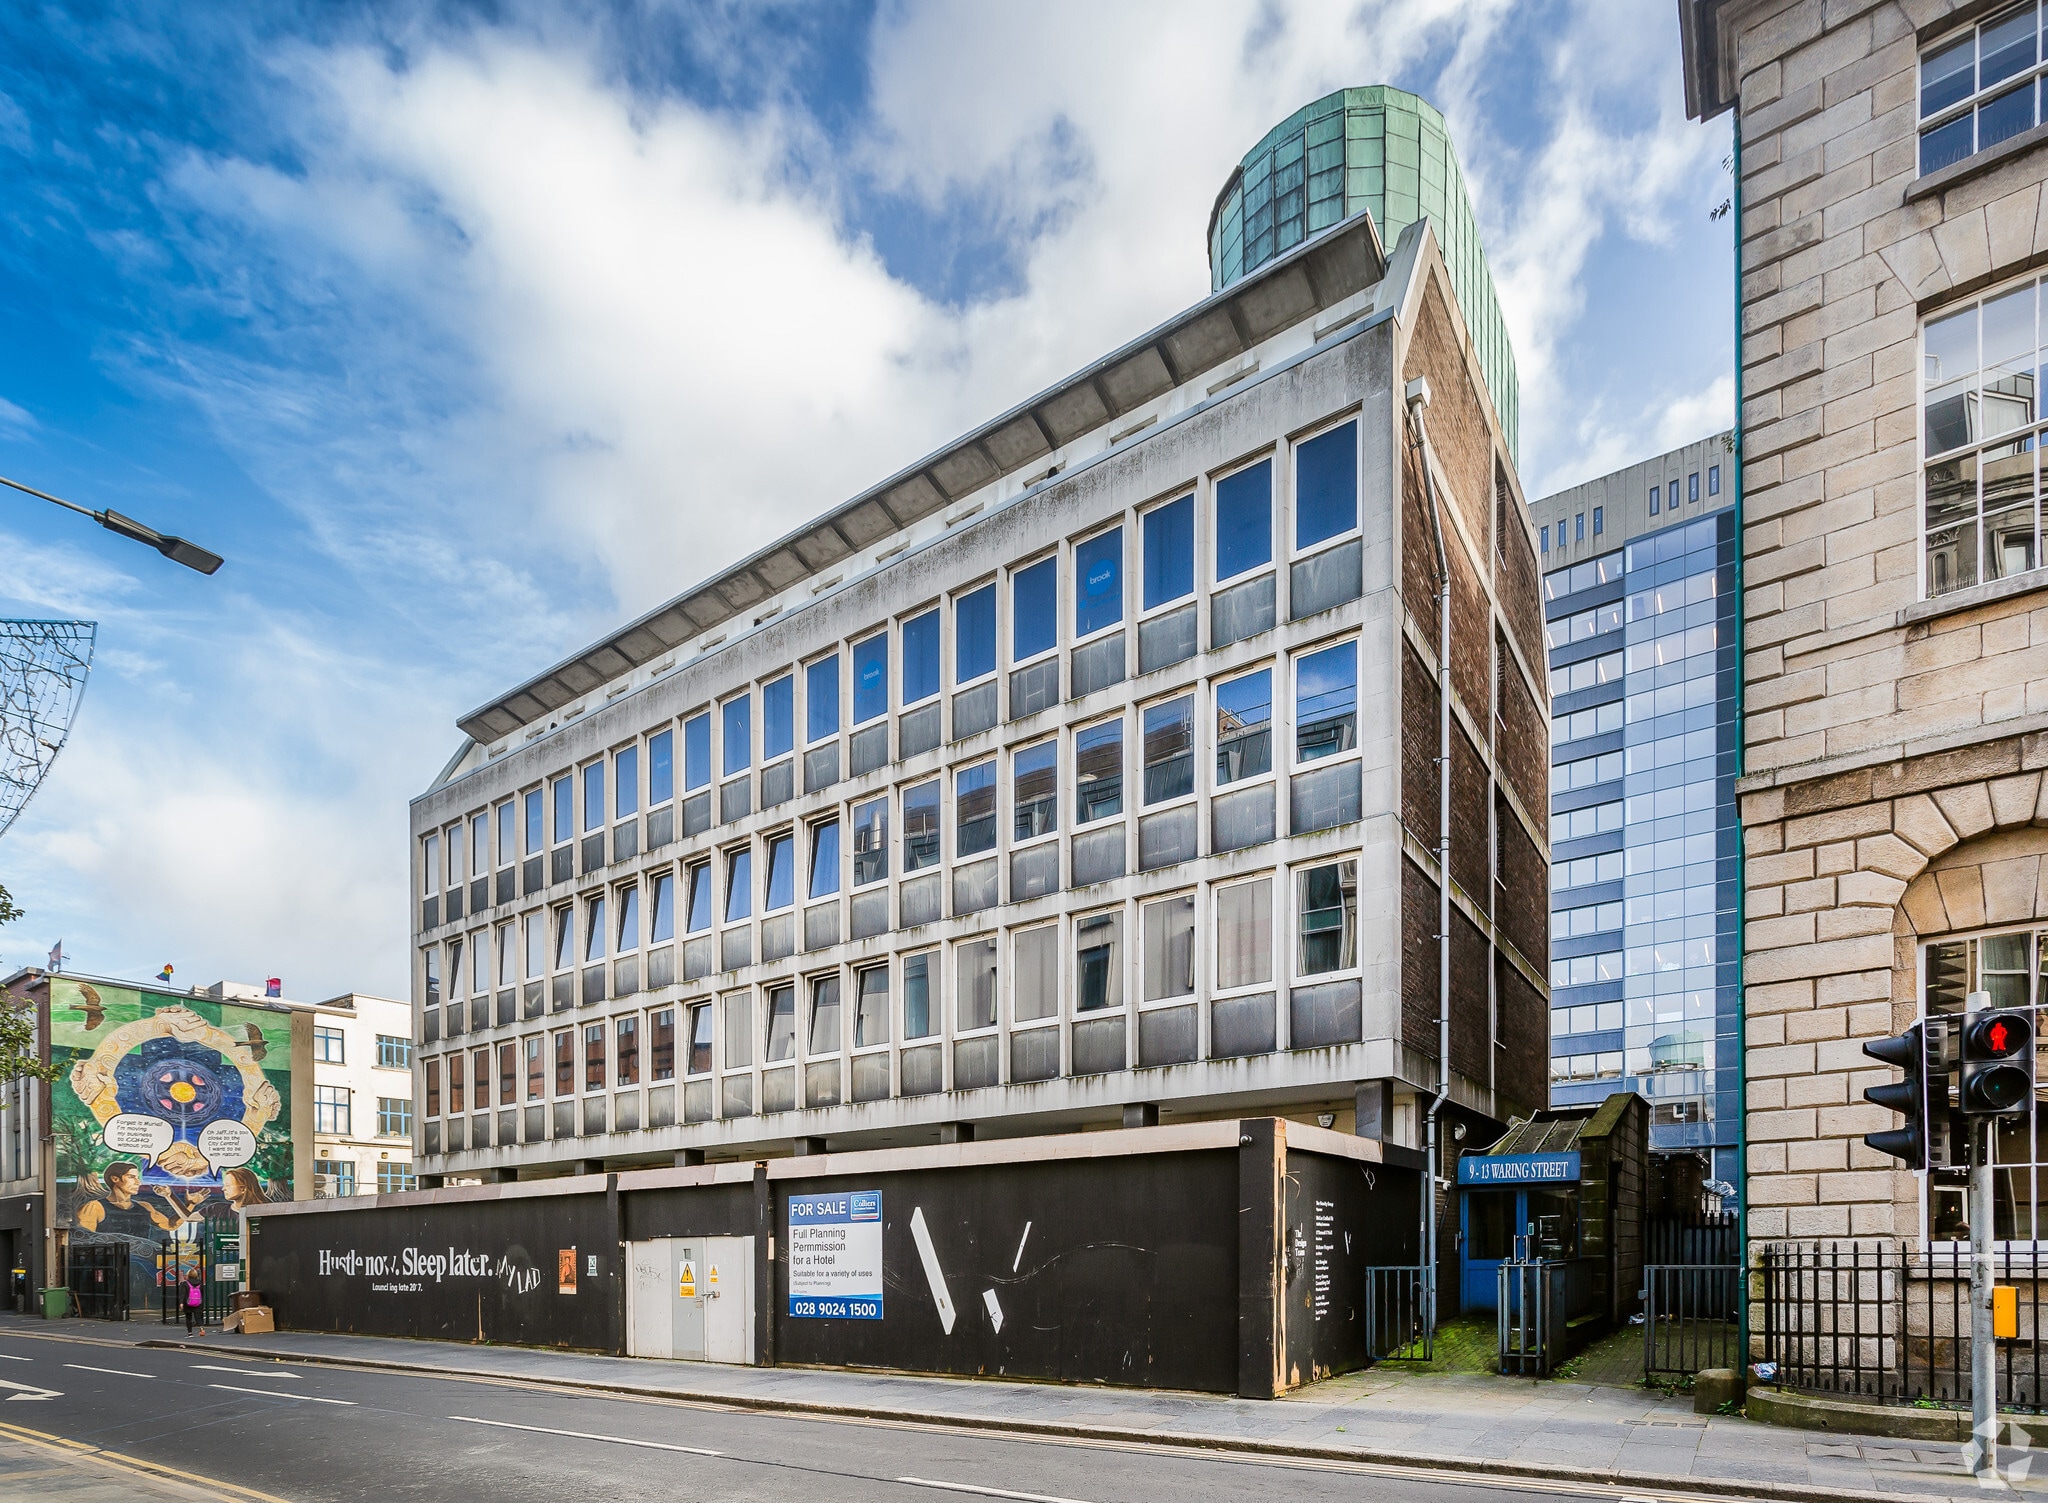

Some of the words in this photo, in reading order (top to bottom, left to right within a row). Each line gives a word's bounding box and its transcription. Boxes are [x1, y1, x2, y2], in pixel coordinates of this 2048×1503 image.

[1090, 570, 1110, 584] brook
[864, 668, 880, 680] brook
[1469, 1164, 1475, 1179] 9
[1481, 1164, 1489, 1179] 13
[1491, 1163, 1529, 1179] WARING
[1531, 1162, 1569, 1178] STREET
[791, 1203, 813, 1217] FOR
[817, 1201, 847, 1216] SALE
[793, 1229, 808, 1239] Full
[810, 1228, 846, 1240] Planning
[793, 1241, 846, 1252] Permmission
[1295, 1238, 1307, 1248] Design
[1295, 1248, 1305, 1256] Team
[402, 1247, 446, 1282] Sleep
[449, 1247, 493, 1276] later.
[793, 1255, 804, 1265] for
[813, 1255, 835, 1265] Hotel
[831, 1270, 849, 1278] variety
[517, 1267, 540, 1294] LAD
[399, 1283, 409, 1291] late
[795, 1302, 815, 1315] 028
[819, 1303, 846, 1315] 9024
[849, 1303, 876, 1316] 1500
